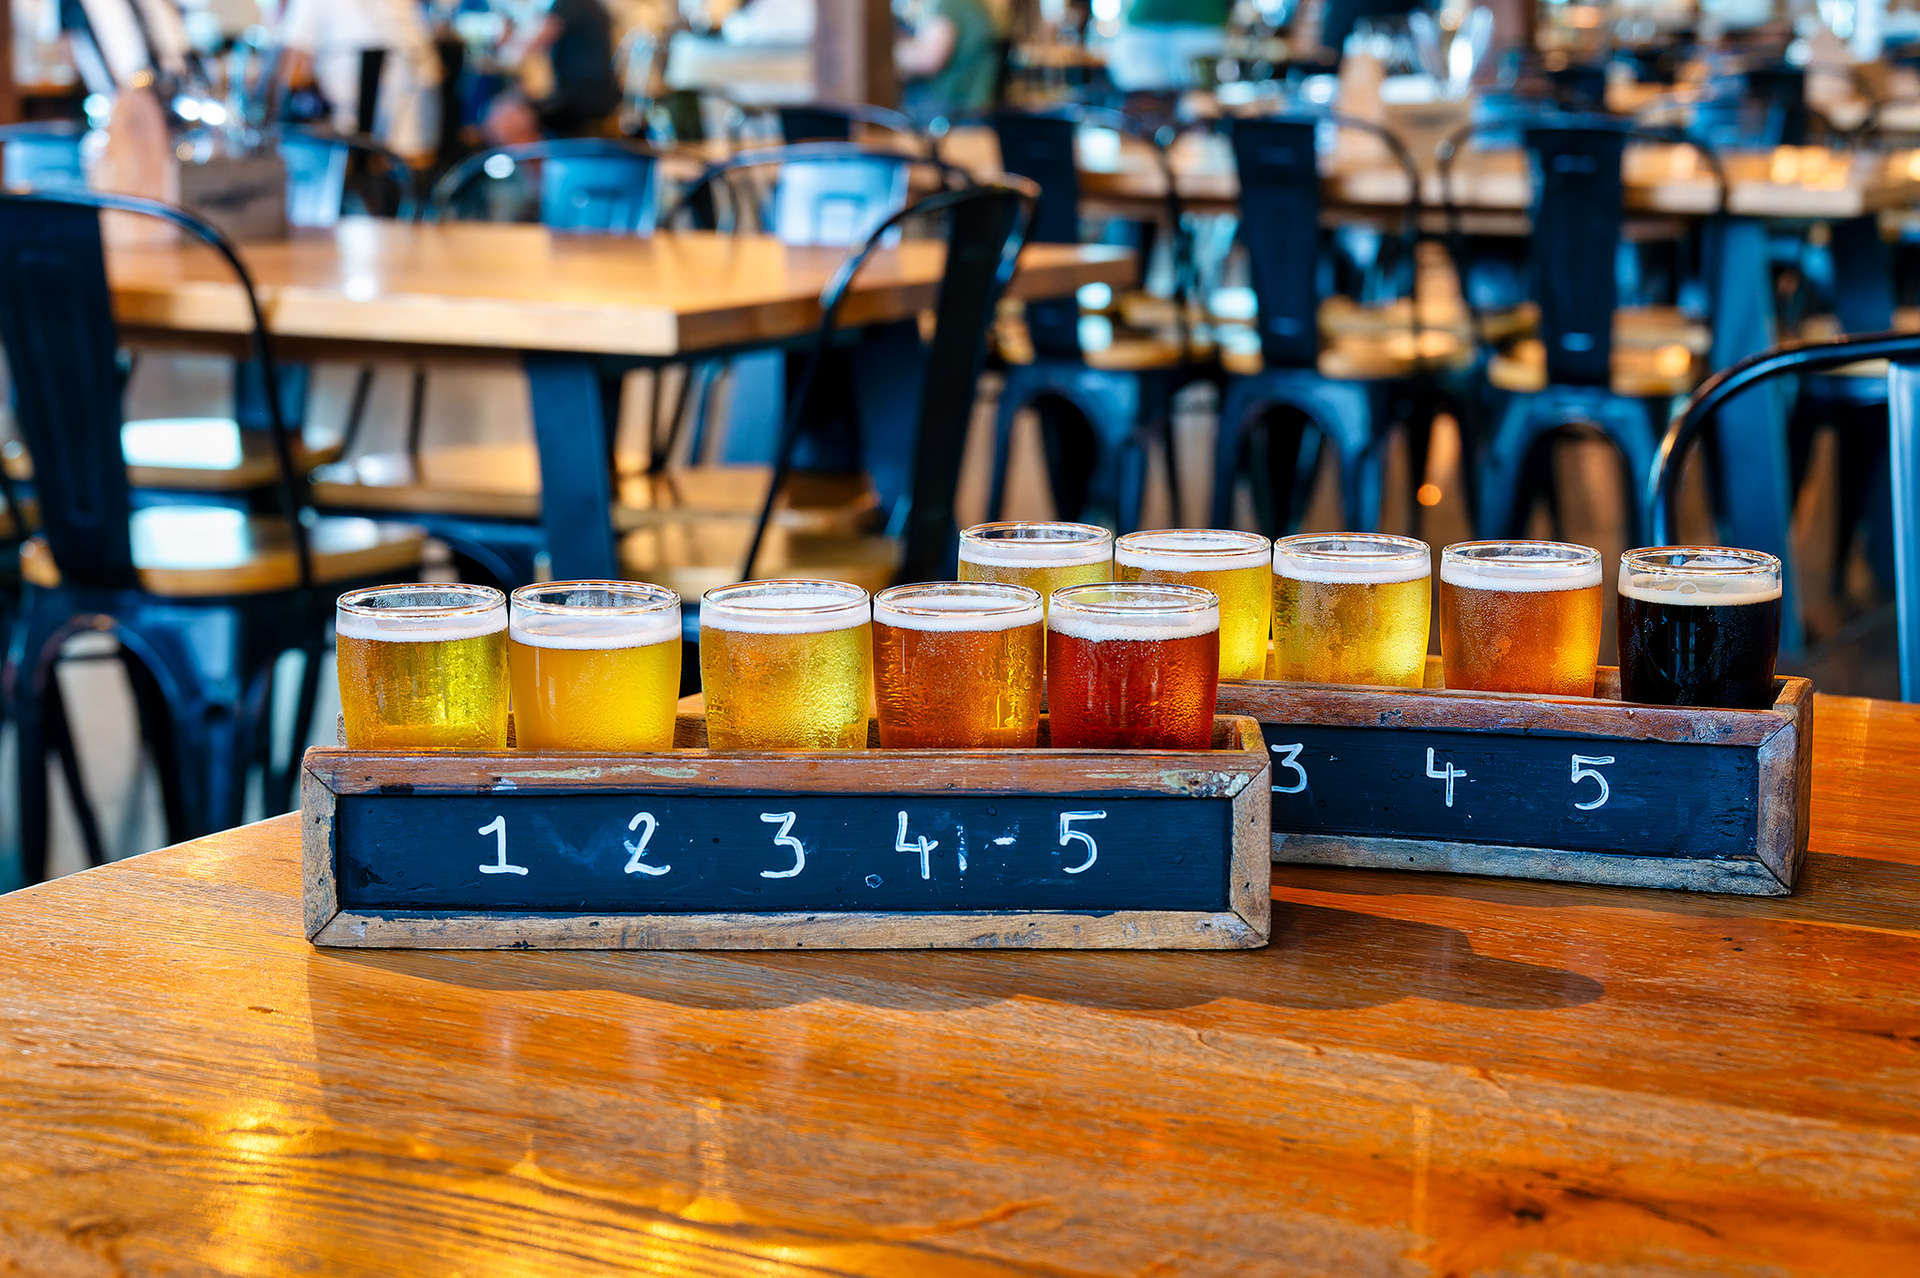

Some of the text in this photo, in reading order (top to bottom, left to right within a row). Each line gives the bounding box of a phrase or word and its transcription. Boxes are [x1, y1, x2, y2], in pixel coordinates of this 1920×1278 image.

[1271, 743, 1615, 810] 3 4 5
[478, 810, 1107, 879] 1 2 3 4 5
